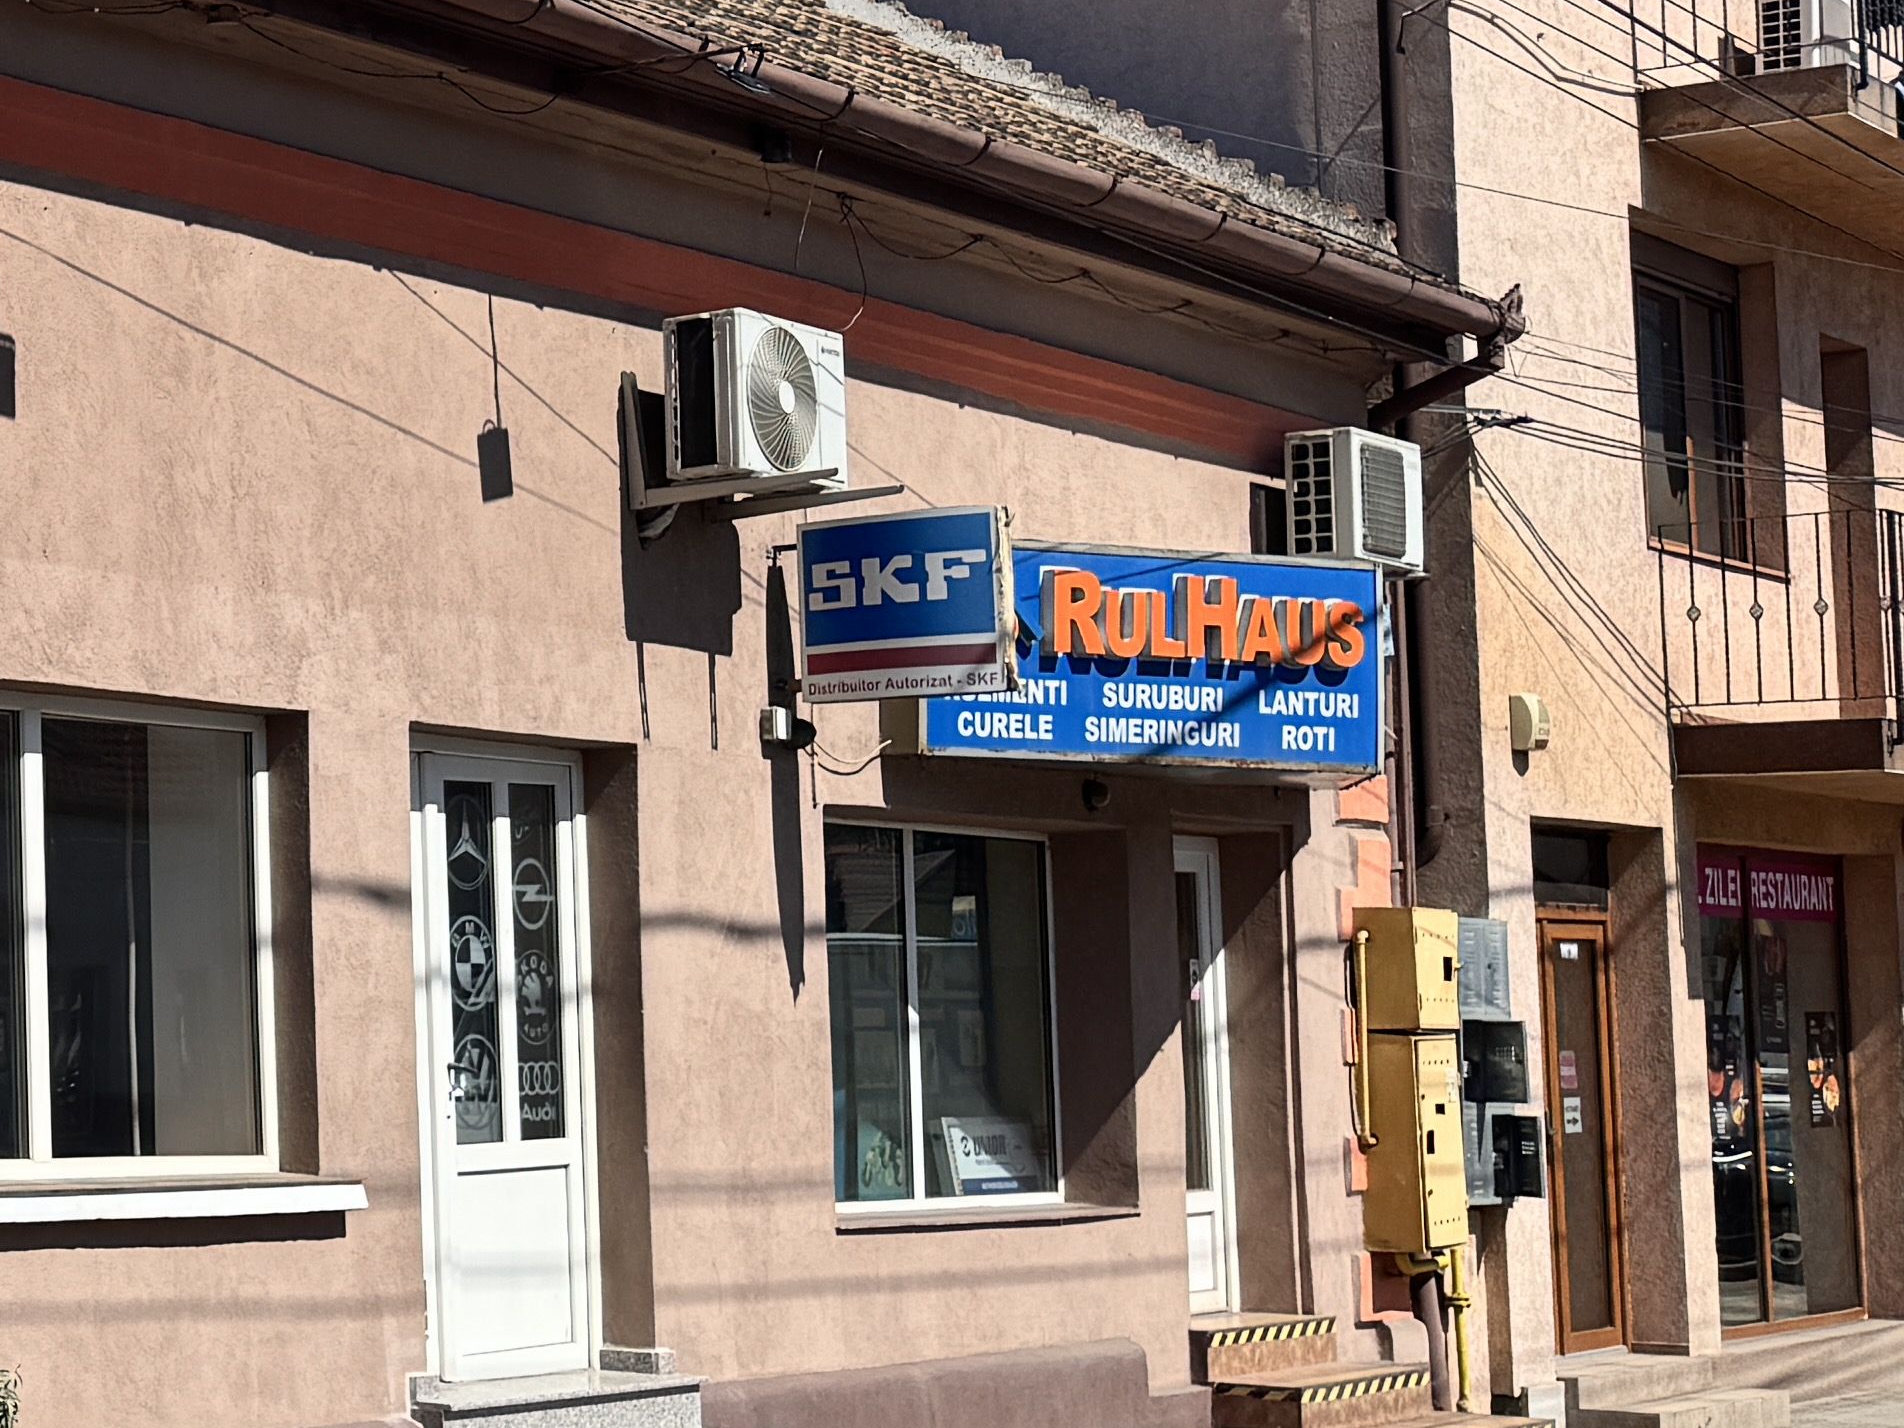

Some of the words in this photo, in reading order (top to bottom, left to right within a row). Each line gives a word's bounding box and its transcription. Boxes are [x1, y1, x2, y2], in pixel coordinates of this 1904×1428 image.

[808, 549, 987, 611] SKF
[808, 680, 881, 696] Distribuitor
[885, 675, 953, 690] Autorizat
[966, 672, 998, 686] SKF
[944, 678, 1067, 705] ENTI
[1102, 681, 1224, 713] SURUBURI
[1258, 690, 1360, 719] LANTURI
[957, 711, 1054, 740] CURELE
[1084, 717, 1241, 748] SIMERINGURI
[1281, 725, 1336, 752] ROTI
[1751, 871, 1834, 911] RESTAURANT
[452, 921, 490, 948] BMW
[522, 1101, 556, 1121] Audi
